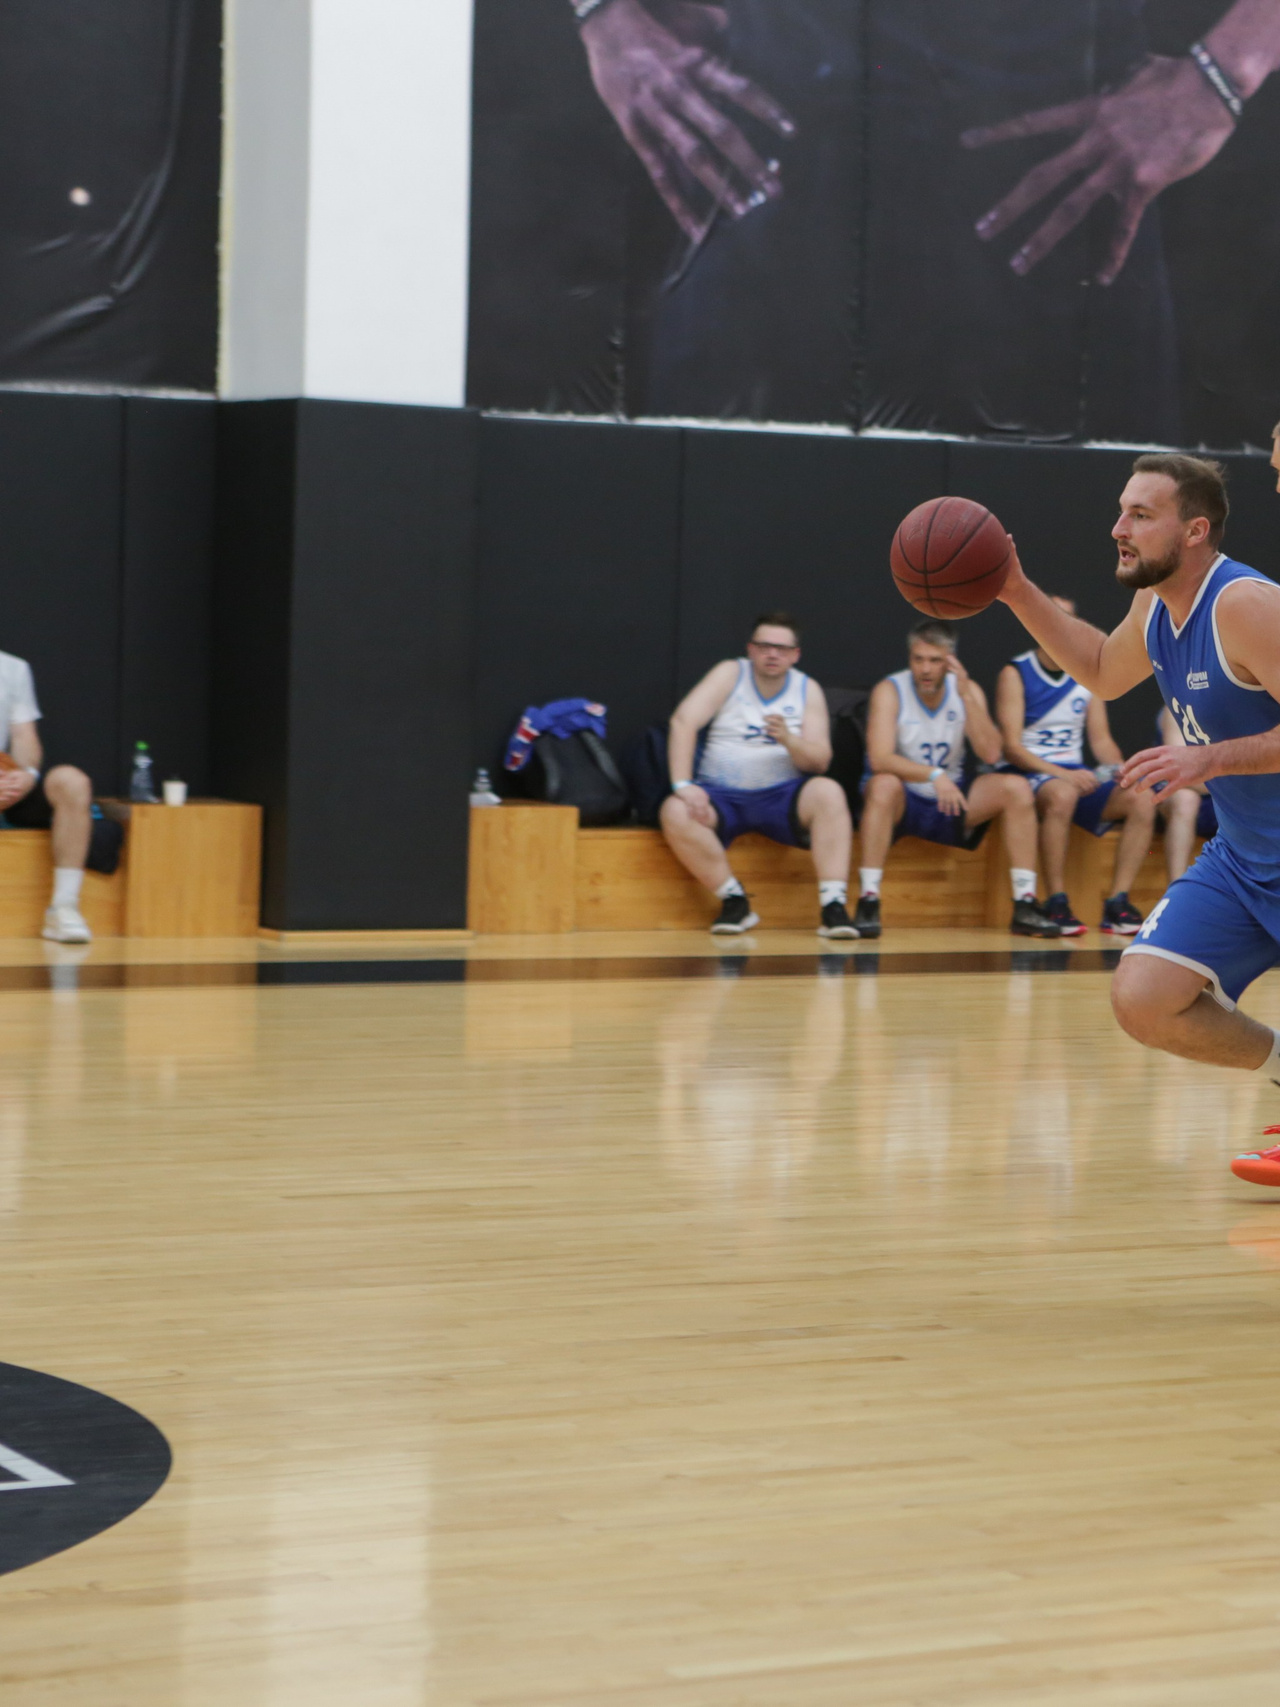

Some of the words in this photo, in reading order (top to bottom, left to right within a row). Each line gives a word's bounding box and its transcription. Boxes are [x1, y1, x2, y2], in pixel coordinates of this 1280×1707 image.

[1171, 696, 1211, 746] 24
[920, 742, 950, 769] 32
[1140, 897, 1170, 939] 4
